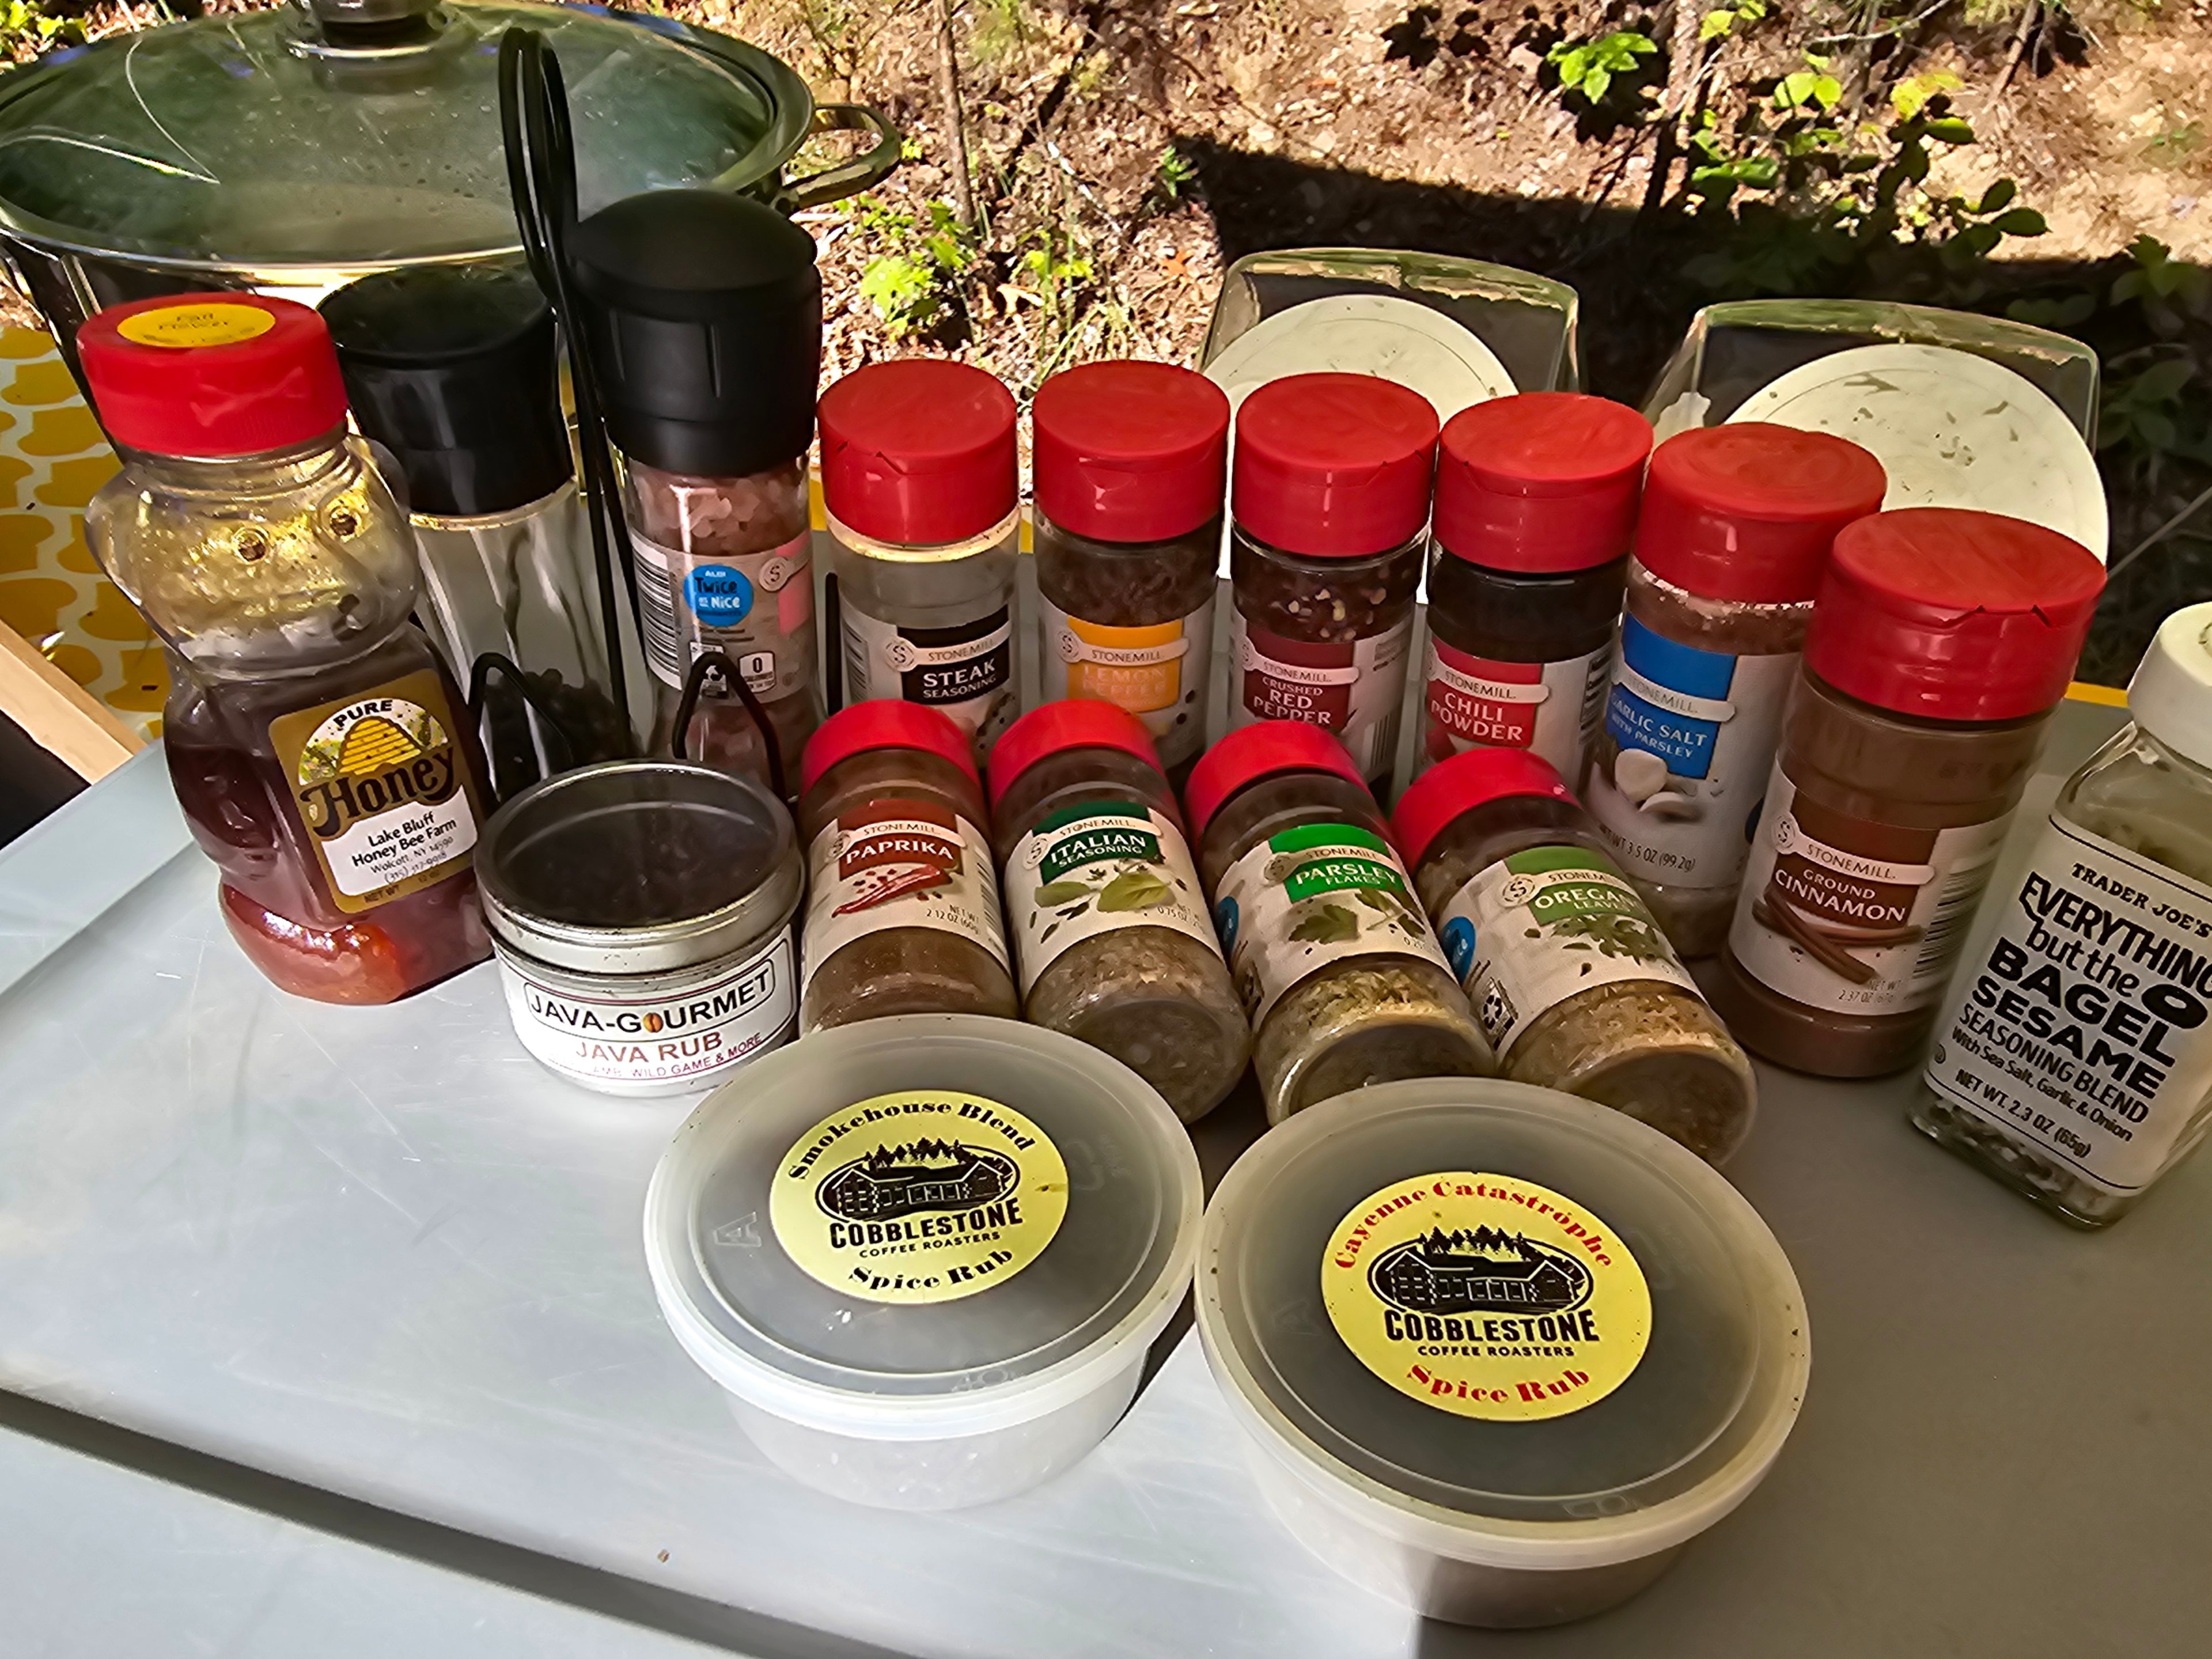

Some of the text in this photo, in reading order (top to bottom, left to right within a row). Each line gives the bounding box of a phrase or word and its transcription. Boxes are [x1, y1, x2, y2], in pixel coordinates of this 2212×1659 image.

[695, 577, 737, 594] Twice
[711, 596, 740, 608] Nice
[928, 638, 995, 661] STONEMILL
[1091, 649, 1162, 662] STONEMILL
[753, 657, 763, 673] 0
[923, 658, 996, 687] STEAK
[1263, 661, 1330, 683] STONEMILL
[923, 676, 997, 699] SEASONING
[1262, 676, 1323, 696] CRUSHED
[1269, 690, 1313, 709] RED
[1445, 671, 1514, 699] STONEMILL
[333, 699, 394, 731] PURE
[1253, 695, 1331, 724] PEPPER
[1430, 700, 1523, 741] POWDER
[1444, 692, 1503, 722] CHILI
[1634, 730, 1694, 757] PARSLEY
[1659, 724, 1707, 747] SALT
[299, 746, 454, 838] Honey
[368, 811, 435, 847] Lake Bluff
[863, 822, 936, 835] STONEMILL
[1059, 819, 1130, 836] STONEMILL
[351, 819, 457, 867] Honey Bee Farm
[846, 839, 954, 865] PAPRIKA
[1050, 834, 1146, 864] ITALIAN
[1059, 844, 1143, 868] SEASONING
[1305, 847, 1376, 859] STONEMILL
[1627, 841, 1642, 858] 3.5
[1643, 847, 1658, 863] OZ
[1296, 863, 1396, 885] PARSLEY
[1806, 844, 1893, 879] STONEMILL
[1325, 875, 1381, 885] FLAKES
[1548, 872, 1616, 883] STONEM
[1802, 868, 1876, 900] GROUND
[1774, 868, 1906, 922] CINNAMON
[2071, 863, 2212, 938] TRADER JOE'S
[2018, 870, 2212, 999] EVERYTHING
[2025, 922, 2140, 998] but the
[530, 968, 770, 1035] JAVA-GOURMET
[1987, 936, 2176, 1068] BAGEL
[575, 1041, 649, 1064] JAVA
[657, 1031, 722, 1061] RUB
[1972, 975, 2167, 1100] SESAME
[631, 1066, 666, 1078] WILD
[671, 1056, 711, 1074] GAME
[715, 1054, 724, 1063] &
[727, 1032, 762, 1058] MORE
[1959, 1003, 2149, 1124] SEASONING BLEND
[1952, 1025, 2133, 1142] With Sea Salt, Garlic & Onion
[1955, 1069, 1984, 1092] NET
[2008, 1100, 2033, 1122] 2.3
[2032, 1114, 2056, 1135] OZ
[788, 1101, 1036, 1181] Smokehouse Blend
[828, 1196, 1024, 1249] COBBLESTONE
[1334, 1181, 1612, 1270] Cayenne Catastrophe
[859, 1231, 1001, 1258] COFFEE ROASTERS
[847, 1249, 1013, 1291] Spice Rub
[1383, 1309, 1600, 1342] COBBLESTONE
[1417, 1345, 1575, 1357] COFFEE ROASTERS
[1407, 1363, 1590, 1403] Spice Rub
